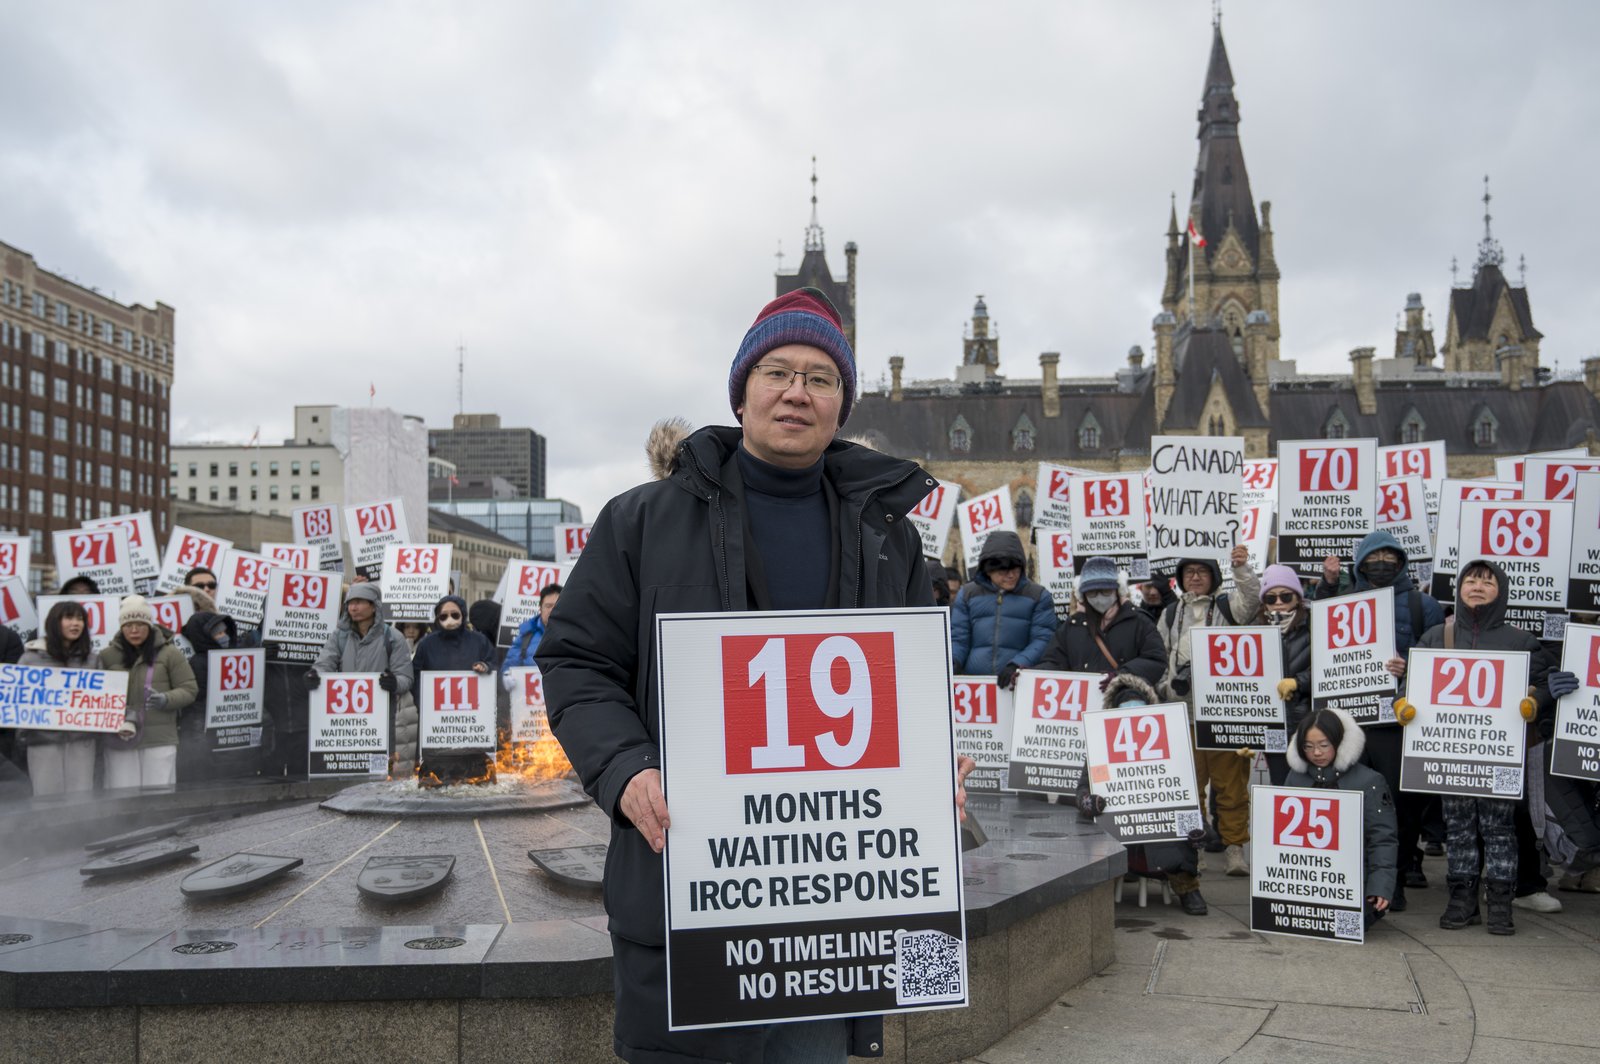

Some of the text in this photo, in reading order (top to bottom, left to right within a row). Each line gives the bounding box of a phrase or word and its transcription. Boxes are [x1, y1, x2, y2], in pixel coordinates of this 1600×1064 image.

[1153, 444, 1244, 476] CANADA
[1392, 450, 1425, 477] 19
[1305, 448, 1352, 490] 70
[1089, 480, 1124, 515] 13
[1152, 487, 1238, 516] WHAT ARE
[1304, 495, 1350, 505] MONTHS
[1376, 484, 1406, 522] 23
[361, 504, 392, 535] 20
[972, 497, 999, 532] 32
[1292, 507, 1363, 518] WAITING FOR
[306, 511, 330, 537] 68
[1090, 521, 1126, 529] MONTHS
[1285, 519, 1369, 531] IRCC RESPONSE
[366, 534, 395, 545] MONTHS
[921, 533, 936, 542] FOR
[1081, 531, 1136, 541] WAITING FOR
[1152, 519, 1239, 549] YOU DOING?
[1489, 509, 1542, 556] 68
[1077, 540, 1142, 551] IRCC RESPONSE
[1295, 538, 1309, 547] NO
[1403, 535, 1420, 545] FOR
[75, 534, 109, 566] 27
[181, 537, 212, 570] 31
[1299, 547, 1354, 557] NO RESULTS
[400, 548, 434, 573] 36
[1300, 563, 1312, 571] NO
[78, 569, 113, 577] MONTHS
[237, 559, 269, 591] 39
[522, 566, 556, 595] 30
[1529, 576, 1554, 587] FOR
[287, 575, 323, 609] 39
[225, 599, 257, 610] WAITING
[285, 610, 319, 620] MONTHS
[275, 619, 328, 630] WAITING FOR
[1332, 600, 1372, 648] 30
[269, 629, 287, 637] IRCC
[1214, 634, 1257, 676] 30
[1333, 650, 1372, 664] MONTHS
[224, 656, 251, 689] 39
[1324, 661, 1383, 678] WAITING FOR
[1, 666, 105, 689] STOP THE
[1318, 674, 1390, 691] IRCC RESPONSE
[1437, 658, 1496, 707] 20
[440, 677, 473, 710] 11
[1215, 682, 1259, 691] MONTHS
[224, 693, 250, 702] MONTHS
[331, 680, 369, 713] 36
[748, 635, 873, 769] 19
[955, 683, 992, 723] 31
[1038, 679, 1082, 720] 34
[1206, 694, 1271, 704] WAITING FOR
[1327, 695, 1380, 708] NO TIMELINES
[216, 702, 256, 712] WAITING FOR
[1201, 707, 1278, 717] IRCC RESPONSE
[227, 712, 258, 721] RESPONSE
[331, 718, 368, 726] MONTHS
[1436, 712, 1492, 726] MONTHS
[321, 728, 377, 737] WAITING FOR
[956, 729, 992, 738] MONTHS
[1036, 724, 1078, 736] MONTHS
[1211, 724, 1223, 733] NO
[1421, 726, 1507, 741] WAITING FOR
[1565, 722, 1597, 737] IRCC
[315, 738, 382, 747] IRCC RESPONSE
[426, 735, 490, 744] IRCC RESPONSE
[985, 741, 1003, 750] FOR
[1024, 736, 1066, 748] WAITING
[1114, 716, 1163, 761] 42
[1215, 735, 1265, 744] NO RESULTS
[1017, 747, 1087, 762] IRCC RESPONS
[1412, 741, 1514, 757] IRCC RESPONSE
[1578, 746, 1595, 758] NO
[323, 753, 334, 761] NO
[326, 761, 370, 770] NO RESULTS
[1025, 766, 1082, 778] NO TIMELINES
[1116, 764, 1166, 778] MONTHS
[1423, 762, 1439, 772] NO
[1582, 760, 1599, 771] NO
[965, 780, 997, 788] RESULTS
[1028, 776, 1078, 788] NO RESULTS
[1106, 777, 1181, 793] WAITING FOR
[1427, 774, 1493, 788] NO RESULTS
[1129, 790, 1190, 804] RESPONSE
[743, 788, 882, 825] MONTHS
[1114, 811, 1175, 825] NO TIMELINE
[1279, 797, 1332, 848] 25
[1120, 823, 1176, 836] NO RESULTS
[708, 827, 919, 868] WAITING FOR
[1279, 853, 1331, 868] MONTHS
[1266, 866, 1346, 885] WAITING FOR
[689, 867, 940, 912] IRCC RESPONSE
[1259, 880, 1353, 901] IRCC RESPONSE
[1271, 903, 1285, 914] NO
[1275, 915, 1335, 932] NO RESULTS
[726, 938, 763, 966] NO
[739, 963, 896, 1000] NO RESULTS
